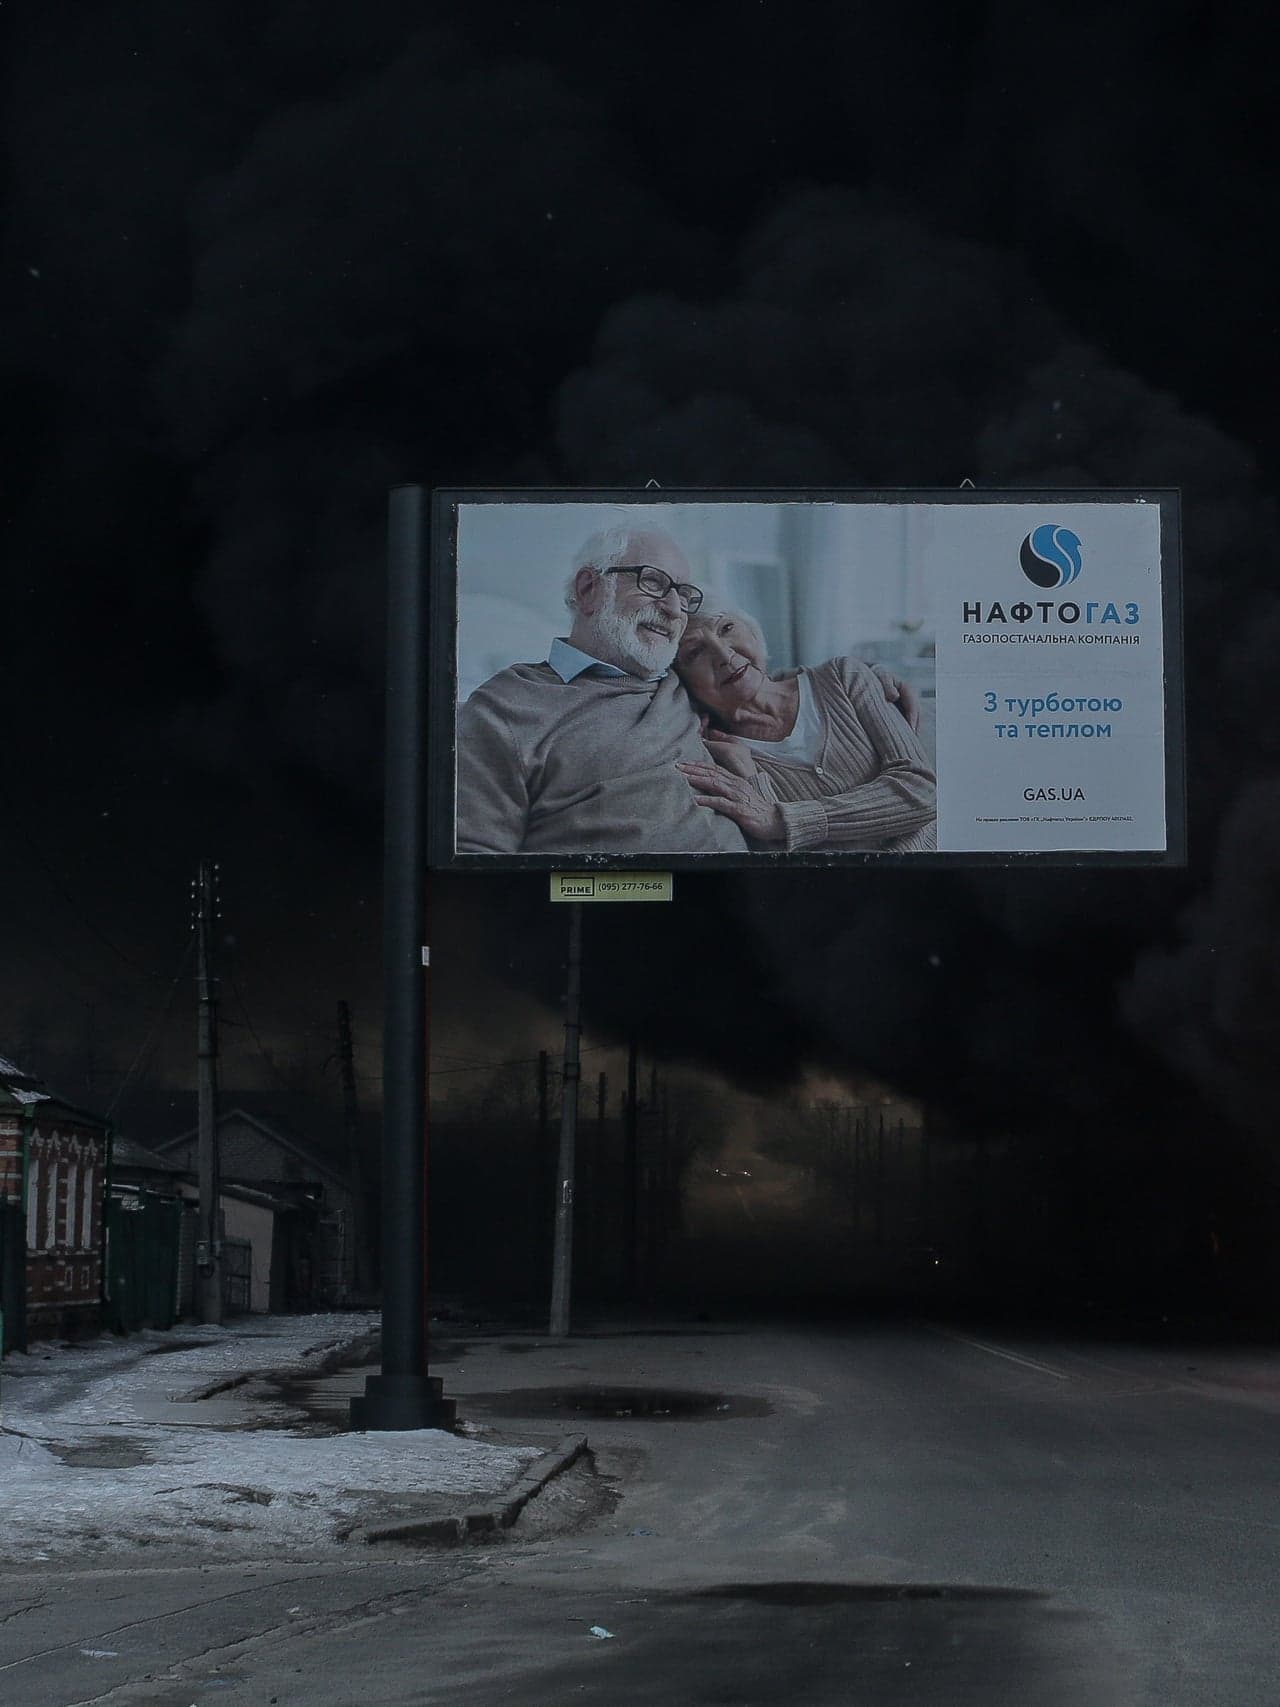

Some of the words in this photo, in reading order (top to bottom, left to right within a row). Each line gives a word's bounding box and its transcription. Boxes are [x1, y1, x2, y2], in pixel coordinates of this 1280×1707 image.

[963, 601, 1140, 624] НАФТОГАЗ
[963, 634, 1075, 645] ГАЗОПОСТАЧАЛЬНА
[1078, 635, 1140, 645] КОМПАНІЯ
[983, 692, 998, 712] З
[1005, 692, 1123, 717] турботою
[995, 724, 1018, 738] та
[1025, 724, 1112, 738] теплом
[1023, 787, 1086, 801] GAS.UA
[561, 886, 592, 894] PRIME
[598, 882, 620, 892] (095)
[622, 882, 663, 891] 277-76-66
